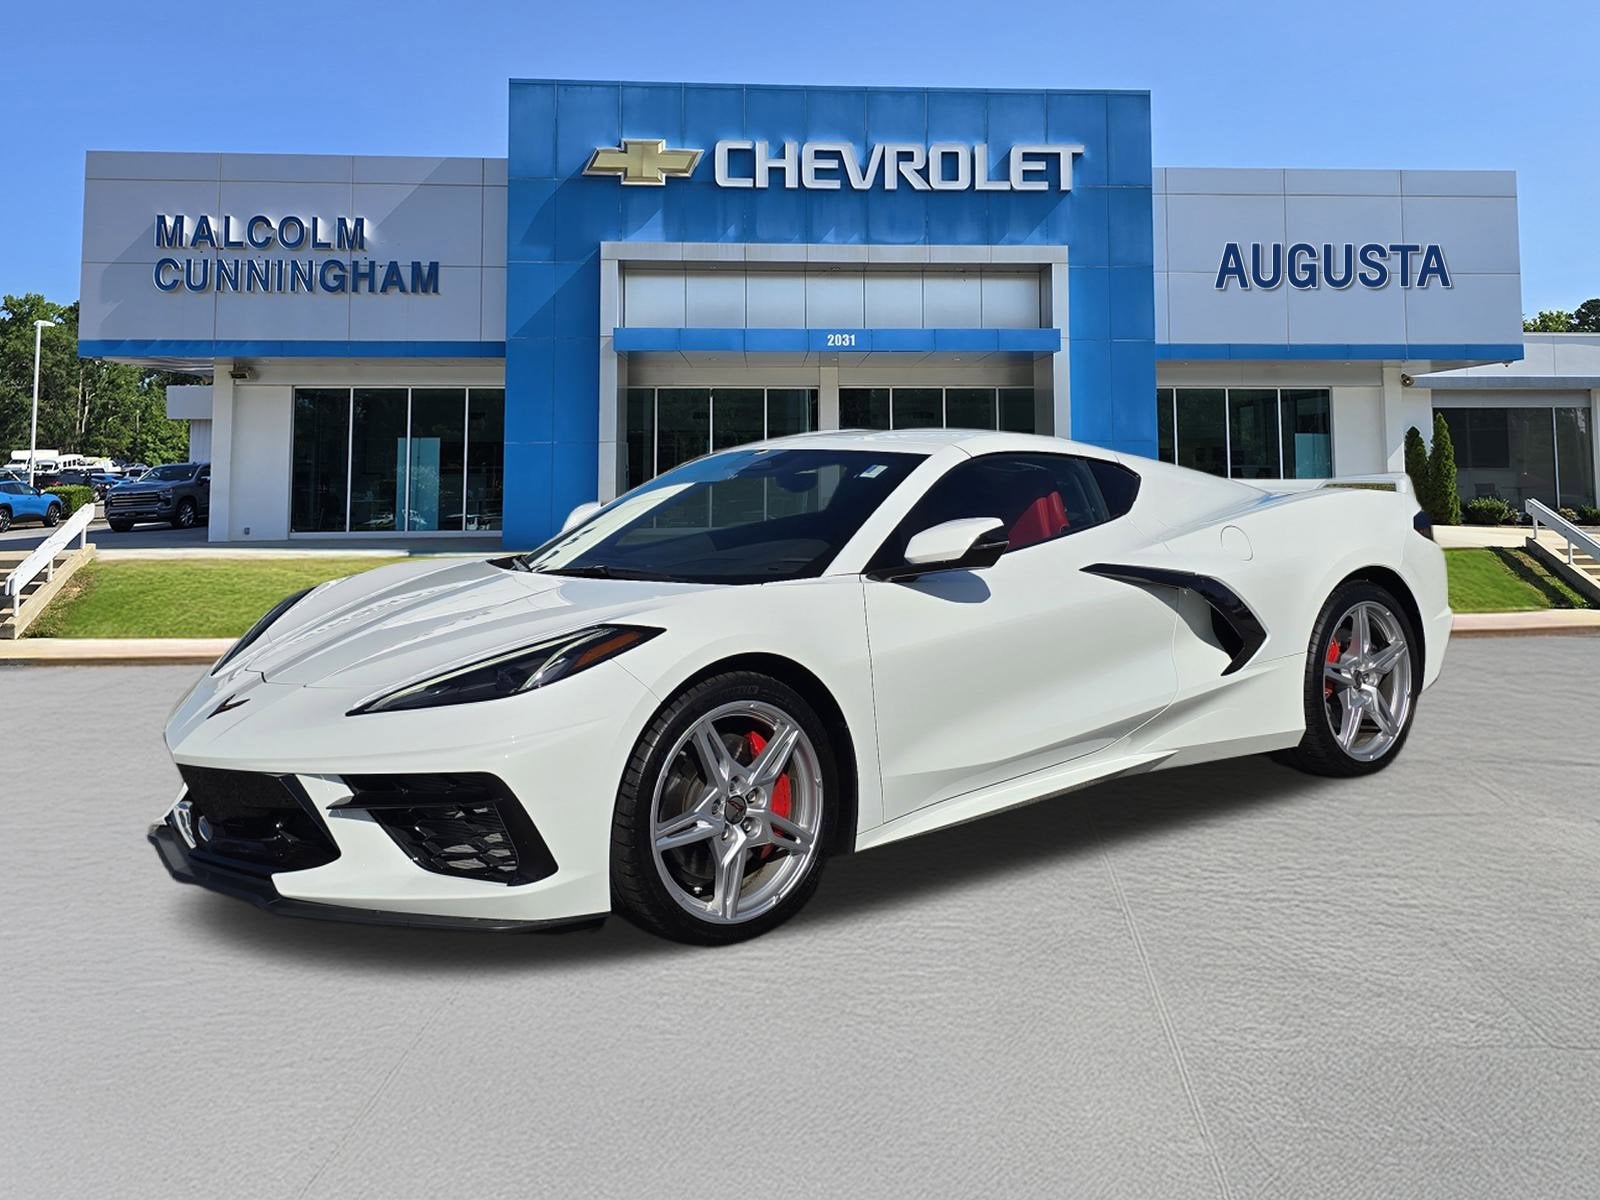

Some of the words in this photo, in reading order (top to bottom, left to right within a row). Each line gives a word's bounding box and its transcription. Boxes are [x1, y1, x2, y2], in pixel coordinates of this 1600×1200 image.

[714, 139, 1085, 192] CHEVROLET
[155, 214, 366, 250] MALCOLM
[154, 257, 440, 294] CUNNINGHAM
[1215, 242, 1452, 289] AUGUSTA
[827, 333, 856, 346] 2031
